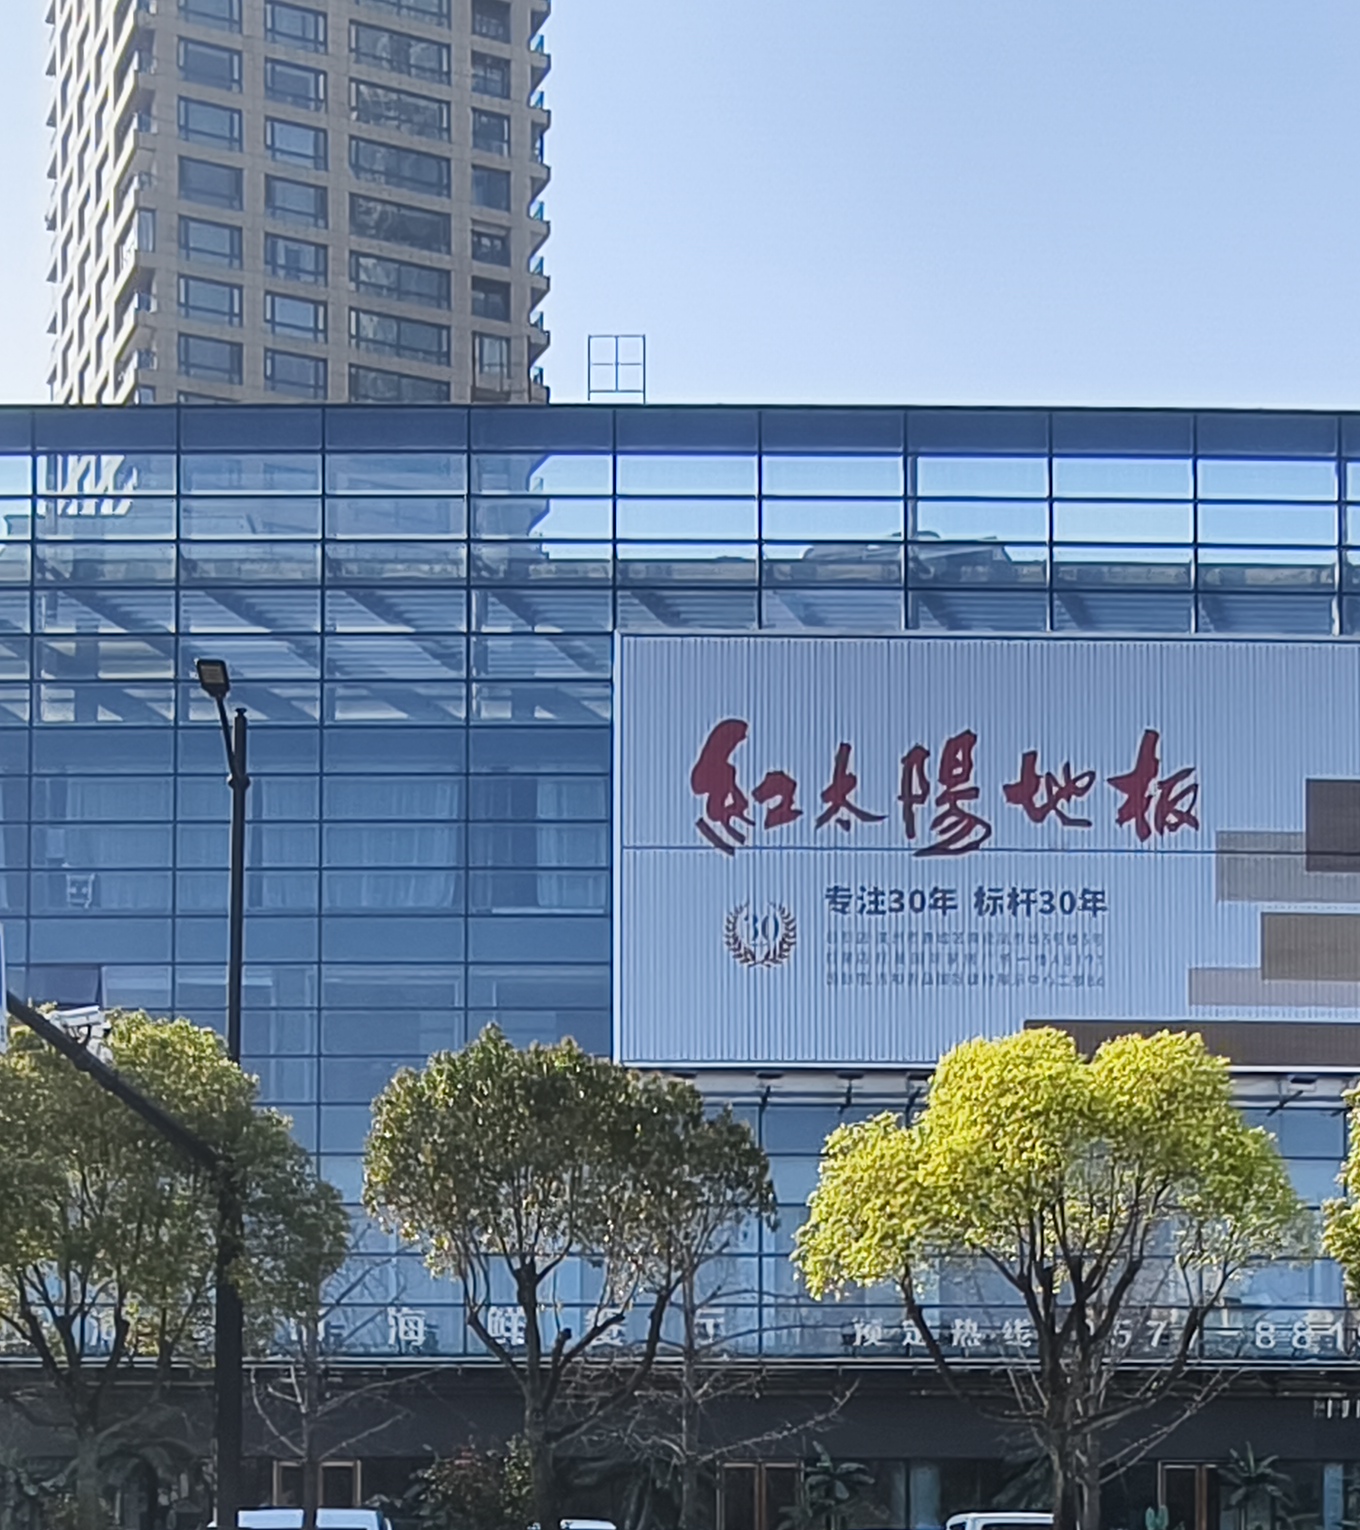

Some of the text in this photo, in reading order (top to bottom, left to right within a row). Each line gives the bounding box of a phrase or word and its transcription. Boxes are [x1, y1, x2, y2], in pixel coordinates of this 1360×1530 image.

[824, 885, 1110, 918] 专注30年 标杆30年
